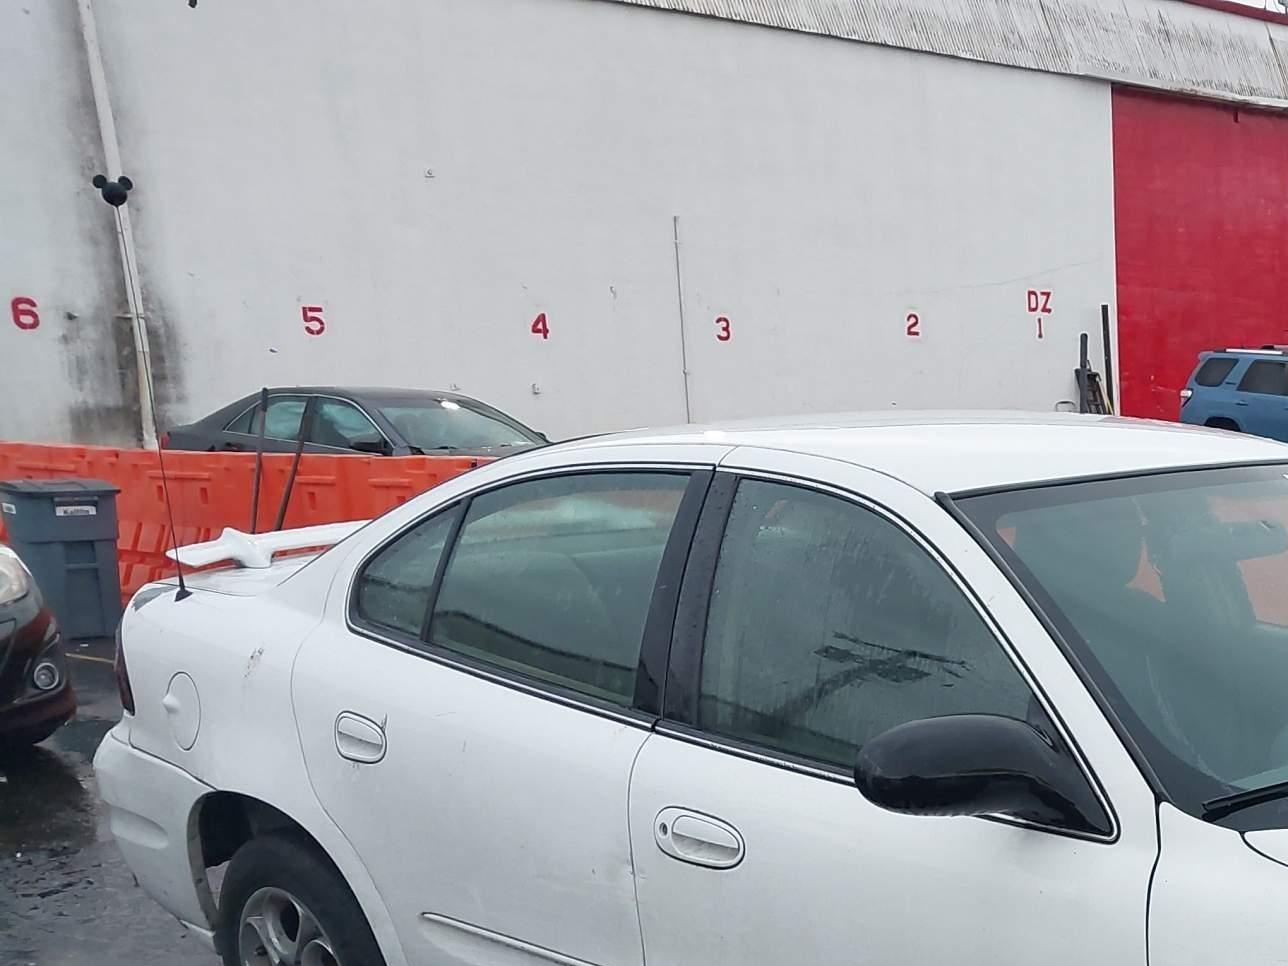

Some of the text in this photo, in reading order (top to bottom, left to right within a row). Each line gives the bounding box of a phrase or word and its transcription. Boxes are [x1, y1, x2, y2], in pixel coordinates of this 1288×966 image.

[11, 297, 40, 330] 6
[1027, 290, 1052, 314] DZ
[302, 306, 325, 335] 5
[531, 313, 549, 339] 4
[715, 317, 730, 341] 3
[906, 313, 919, 336] 2
